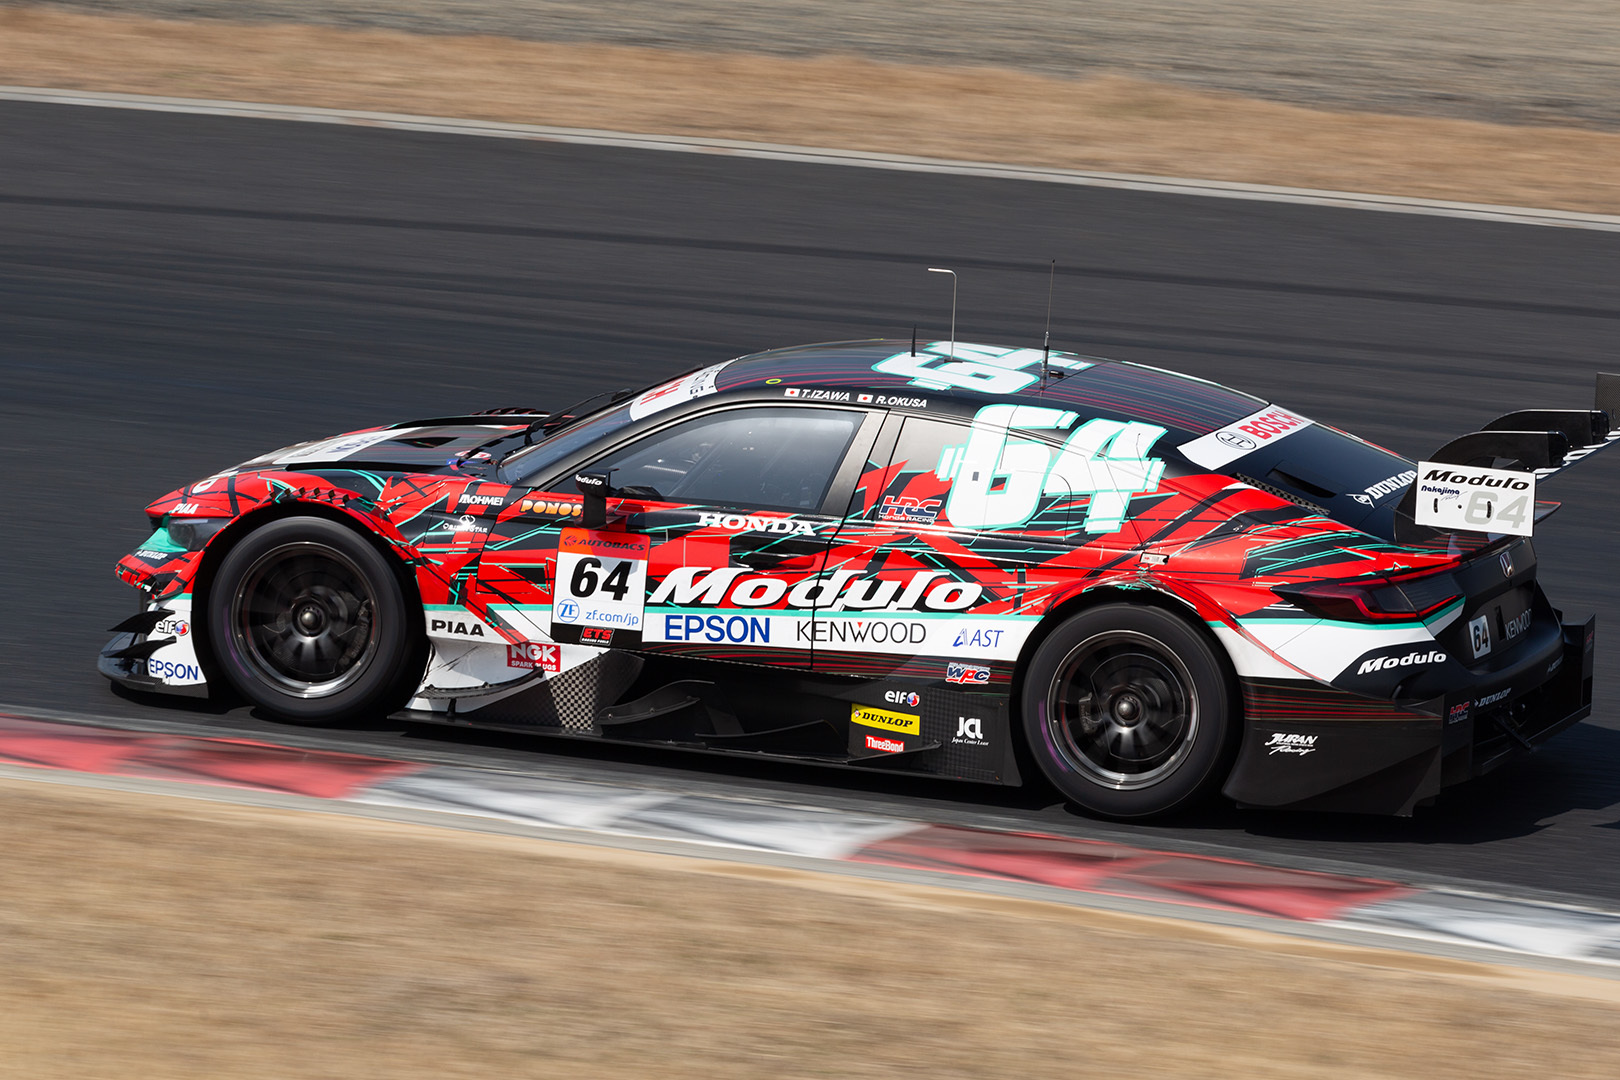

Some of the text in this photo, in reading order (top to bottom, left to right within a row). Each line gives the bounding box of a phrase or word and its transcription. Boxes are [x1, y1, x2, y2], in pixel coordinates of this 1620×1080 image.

[801, 388, 851, 402] T.IZAWA
[875, 394, 928, 408] R.OKUSA
[1238, 409, 1305, 440] BOSCH
[934, 403, 1168, 534] 64
[1364, 469, 1417, 500] DUNLOP
[1423, 469, 1530, 491] Modulo
[171, 502, 200, 515] PIAA
[520, 499, 583, 518] PONOS
[879, 495, 943, 518] HRC
[1465, 490, 1529, 529] 64
[695, 511, 817, 537] HONDA
[578, 538, 645, 551] AUTOBACS
[569, 556, 633, 602] 64
[646, 566, 983, 613] Modulo
[560, 603, 576, 618] ZF
[585, 609, 639, 626] zf.com/jp
[155, 620, 176, 635] elf
[431, 618, 485, 637] PIAA
[583, 627, 612, 640] ETS
[664, 614, 771, 644] EPSON
[795, 620, 927, 645] KENWOOD
[1473, 622, 1489, 653] 64
[511, 643, 557, 664] NGK
[1357, 650, 1447, 676] Modulo
[149, 658, 199, 681] EPSON
[511, 660, 534, 669] SPARK
[884, 690, 907, 704] elf
[862, 711, 913, 728] DUNLOP
[956, 716, 984, 740] JCL
[865, 735, 905, 752] ThreeBond
[1264, 733, 1319, 746] JURAN
